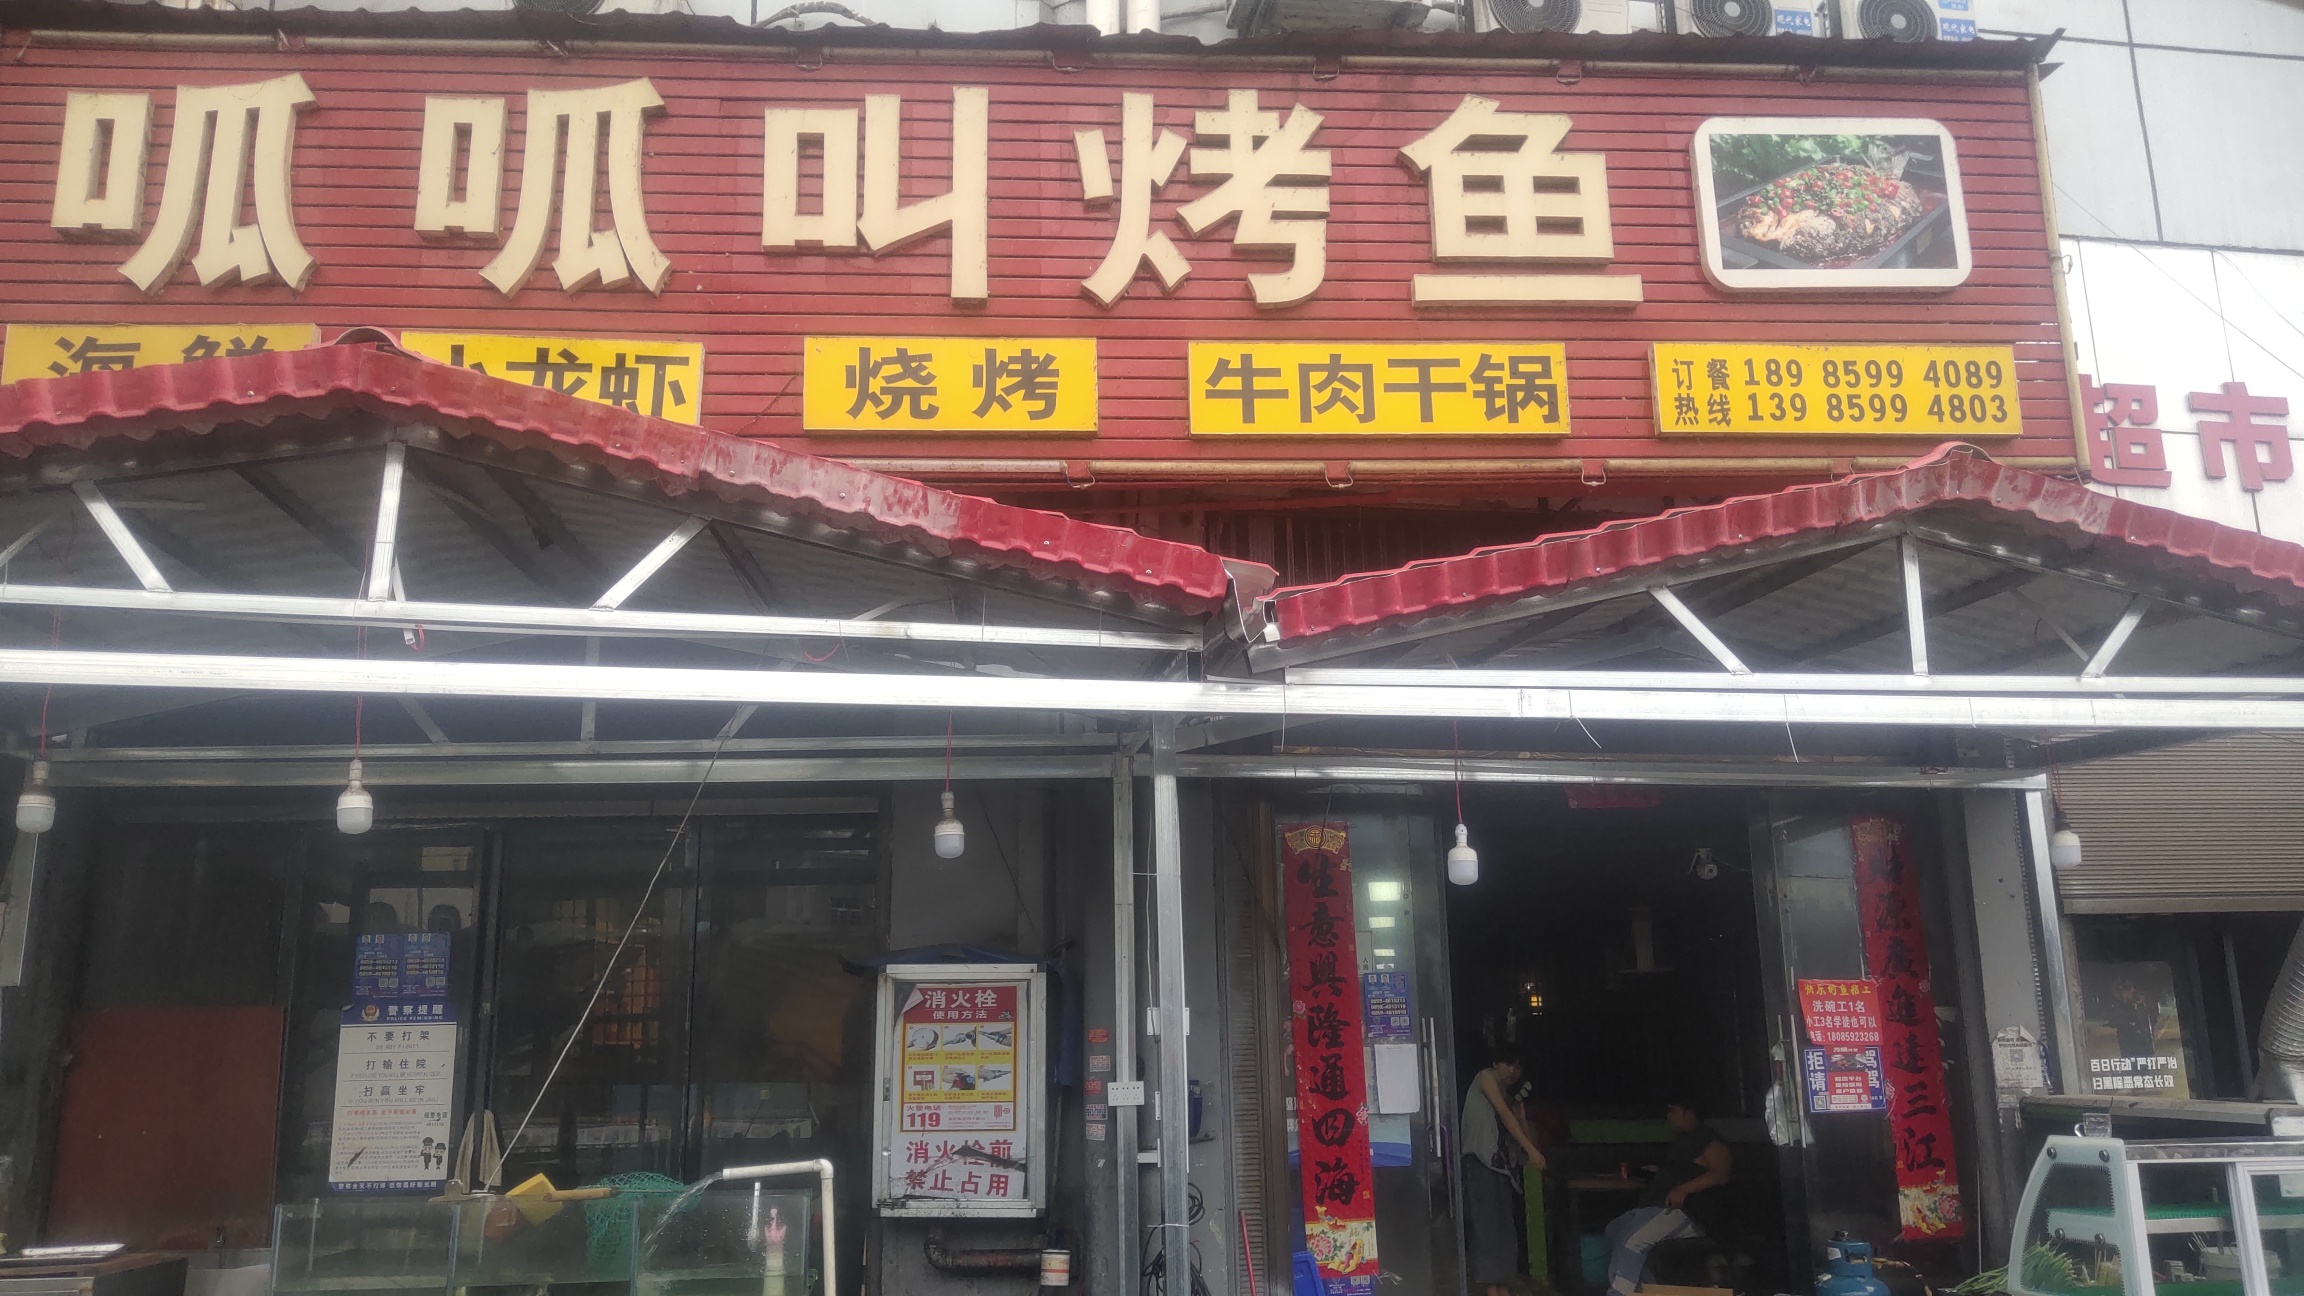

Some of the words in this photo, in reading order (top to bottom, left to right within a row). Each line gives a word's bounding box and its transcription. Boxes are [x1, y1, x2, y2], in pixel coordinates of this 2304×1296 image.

[50, 73, 1643, 308] 呱呱叫烤鱼
[1672, 357, 1731, 391] 订餐
[1744, 358, 1803, 387] 189
[1822, 359, 1904, 388] 8599
[1923, 359, 2002, 388] 4089
[845, 347, 1060, 421] 烧烤
[1205, 353, 1560, 425] 牛肉干锅
[1674, 393, 1732, 427] 热线
[1747, 392, 1807, 422] 139
[1826, 393, 1908, 423] 8599
[1927, 394, 2008, 424] 4803
[2079, 374, 2294, 493] 超市
[925, 989, 998, 1009] 消火栓
[1812, 1000, 1866, 1013] 洗碗工1名
[387, 1004, 443, 1016] 警察提醒
[933, 1010, 988, 1020] 使用方法
[1806, 1015, 1877, 1028] 小工3名学徒也可以
[366, 1030, 430, 1042] 不要打架
[365, 1059, 427, 1071] 打输住院
[363, 1085, 425, 1097] 打赢坐牢
[906, 1112, 941, 1128] 119
[906, 1169, 1009, 1197] 禁止占用
